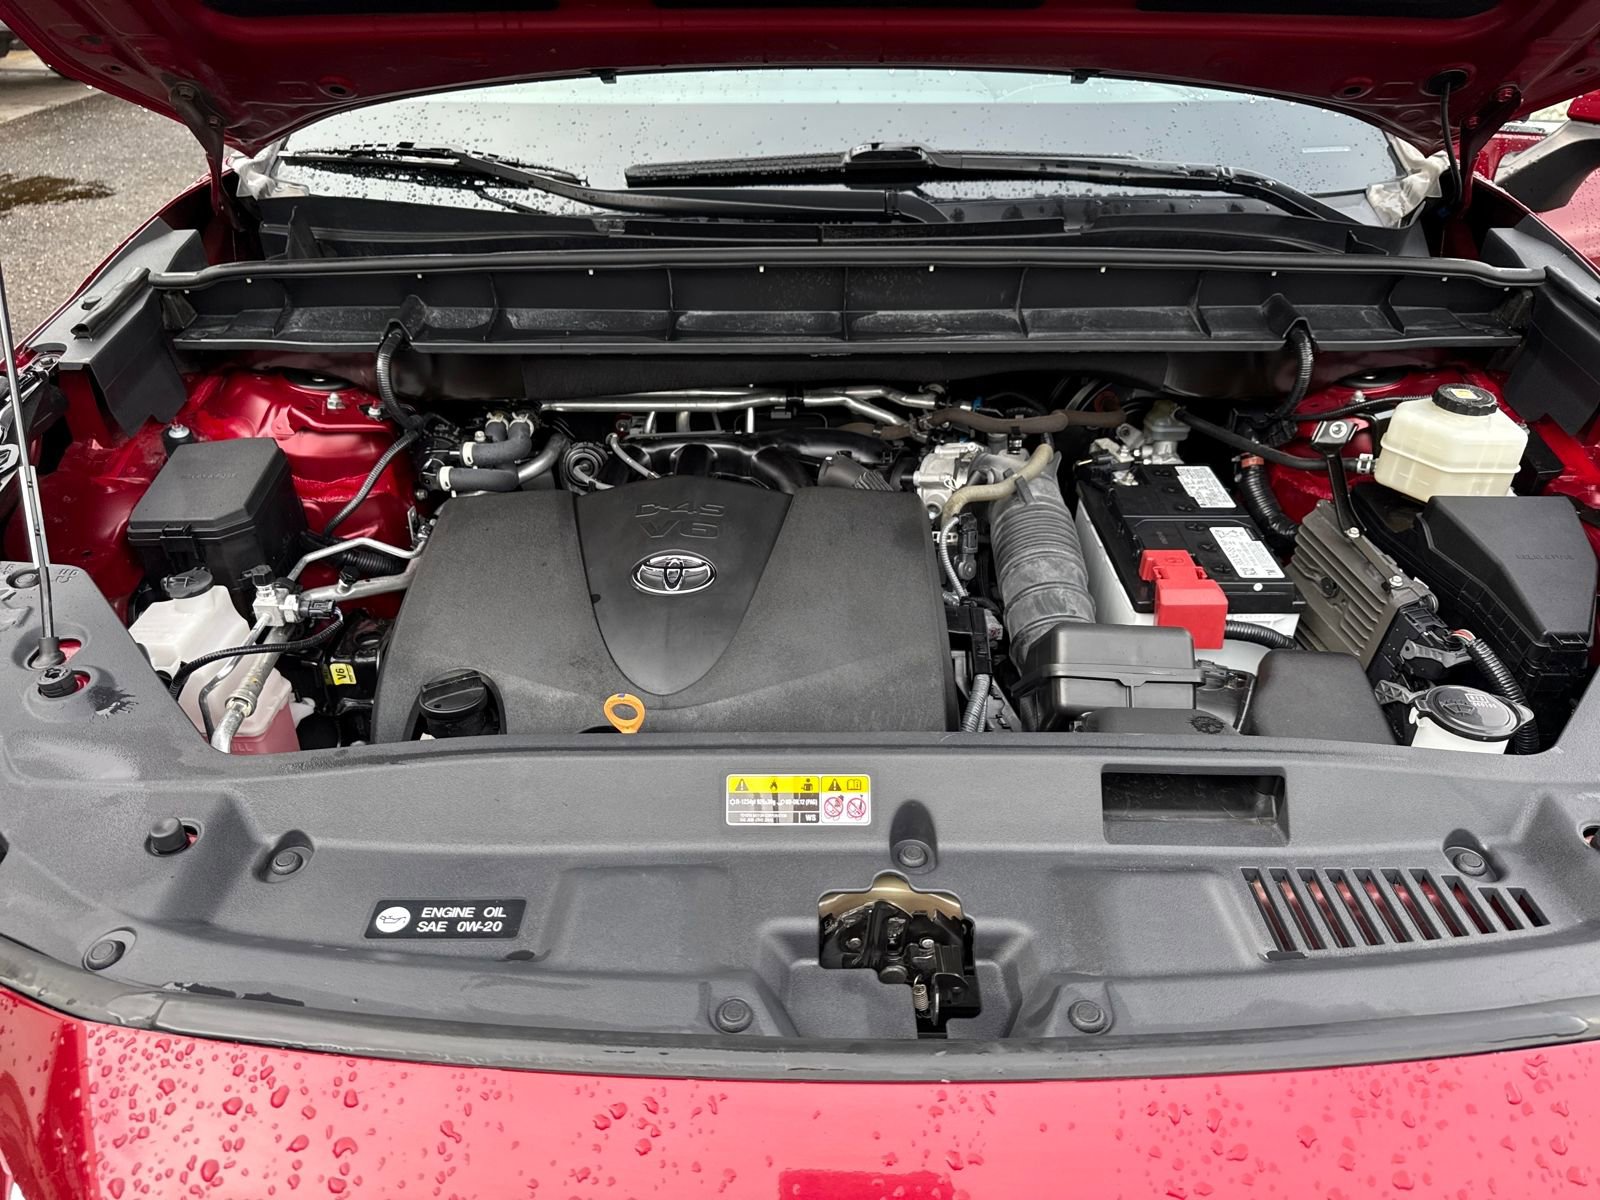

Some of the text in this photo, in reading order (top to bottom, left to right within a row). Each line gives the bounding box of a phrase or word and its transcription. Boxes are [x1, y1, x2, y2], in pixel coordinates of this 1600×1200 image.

[639, 519, 720, 539] V6
[335, 668, 347, 681] V6
[805, 814, 817, 822] WS
[421, 907, 507, 918] ENGINE OIL
[416, 921, 503, 932] SAE 0W-20
